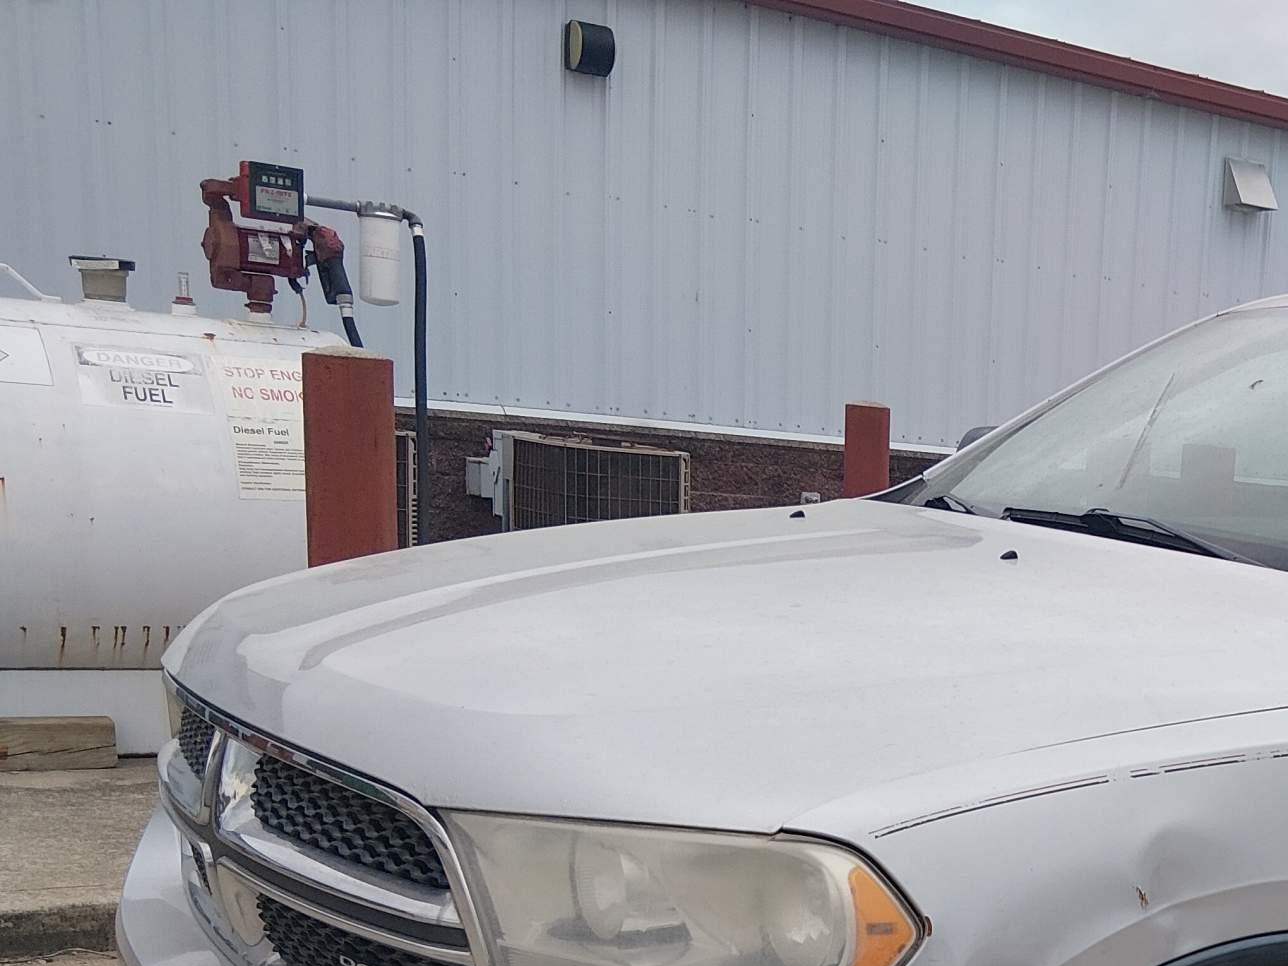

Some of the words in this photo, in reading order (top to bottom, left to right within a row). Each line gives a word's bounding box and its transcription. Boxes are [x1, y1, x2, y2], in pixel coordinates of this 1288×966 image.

[96, 351, 183, 370] DANGER
[109, 368, 180, 388] DIESEL
[223, 366, 265, 379] STOP
[122, 385, 174, 404] FUEL
[233, 425, 265, 435] Diesel
[267, 427, 290, 436] Fuel
